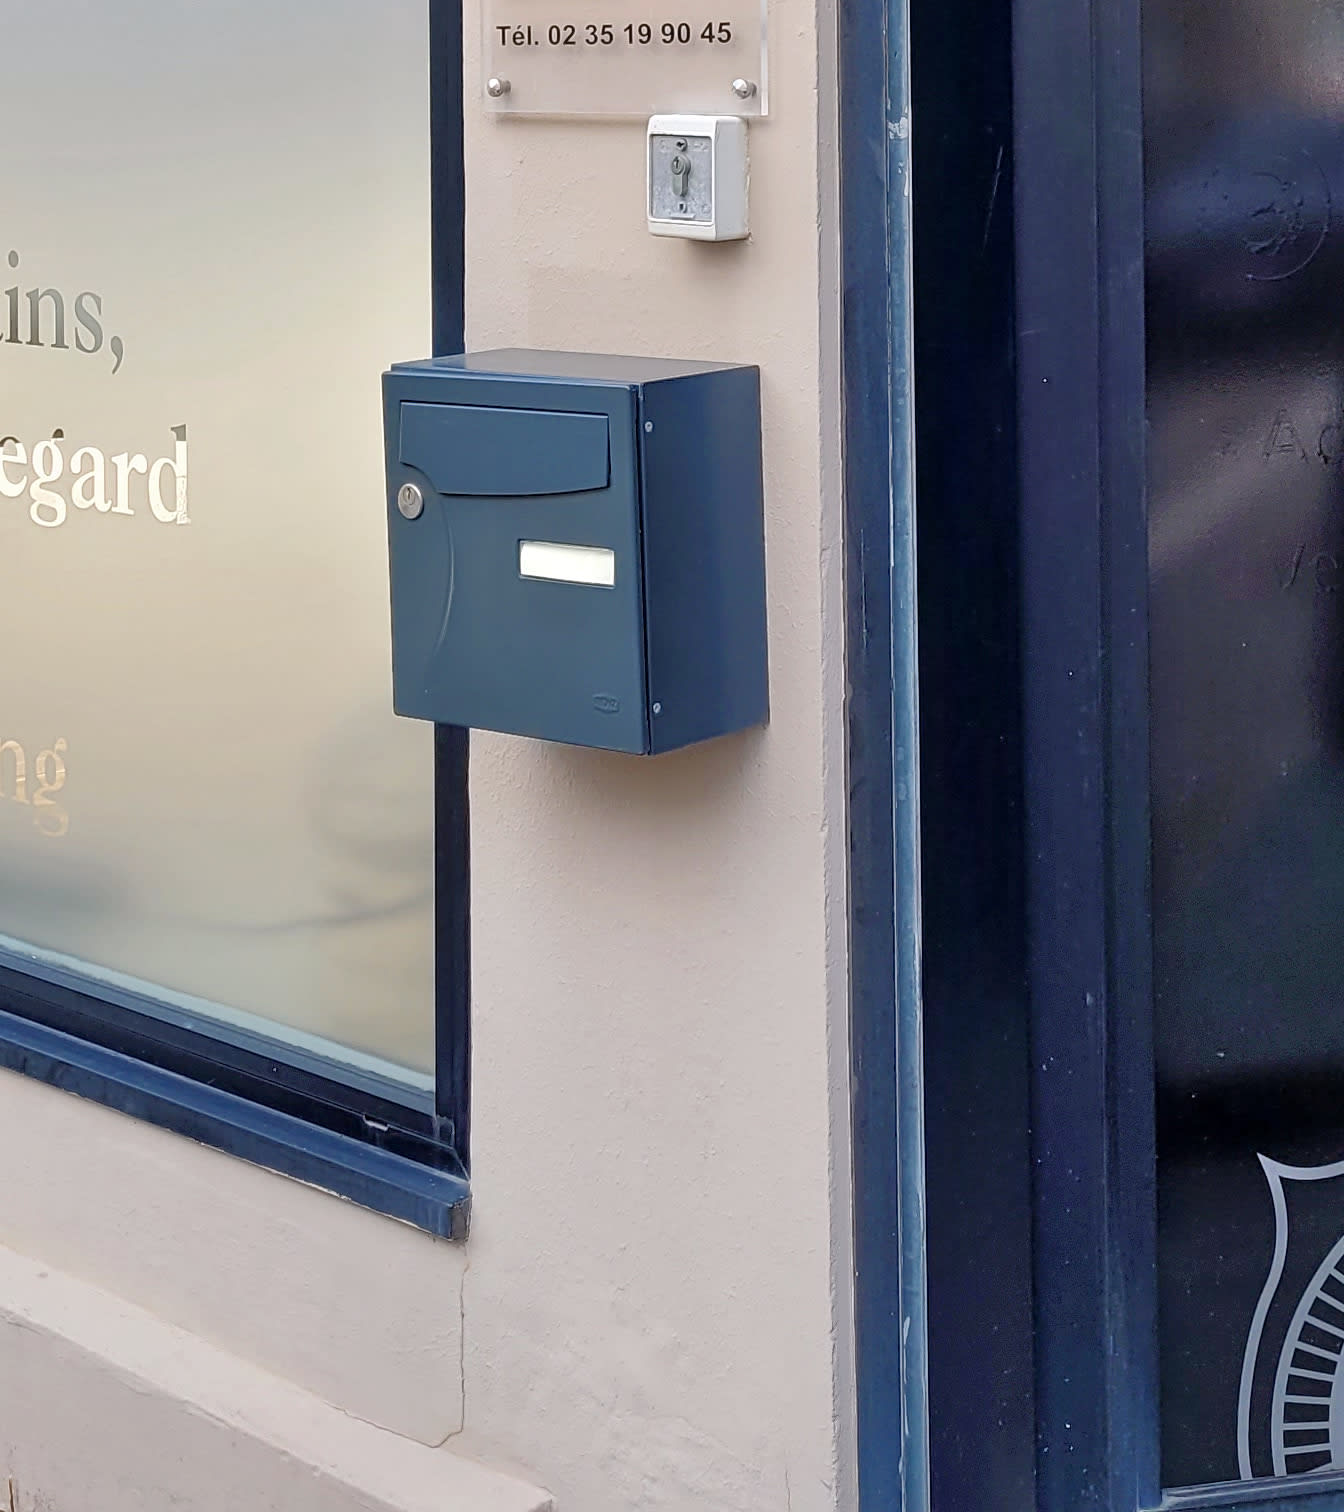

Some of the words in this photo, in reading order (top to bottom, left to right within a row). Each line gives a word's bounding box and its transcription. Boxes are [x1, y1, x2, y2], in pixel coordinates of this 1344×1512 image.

[496, 24, 539, 47] Tél.
[548, 24, 577, 46] 02
[585, 23, 614, 45] 35
[624, 23, 652, 44] 19
[662, 23, 691, 44] 90
[701, 21, 732, 44] 45
